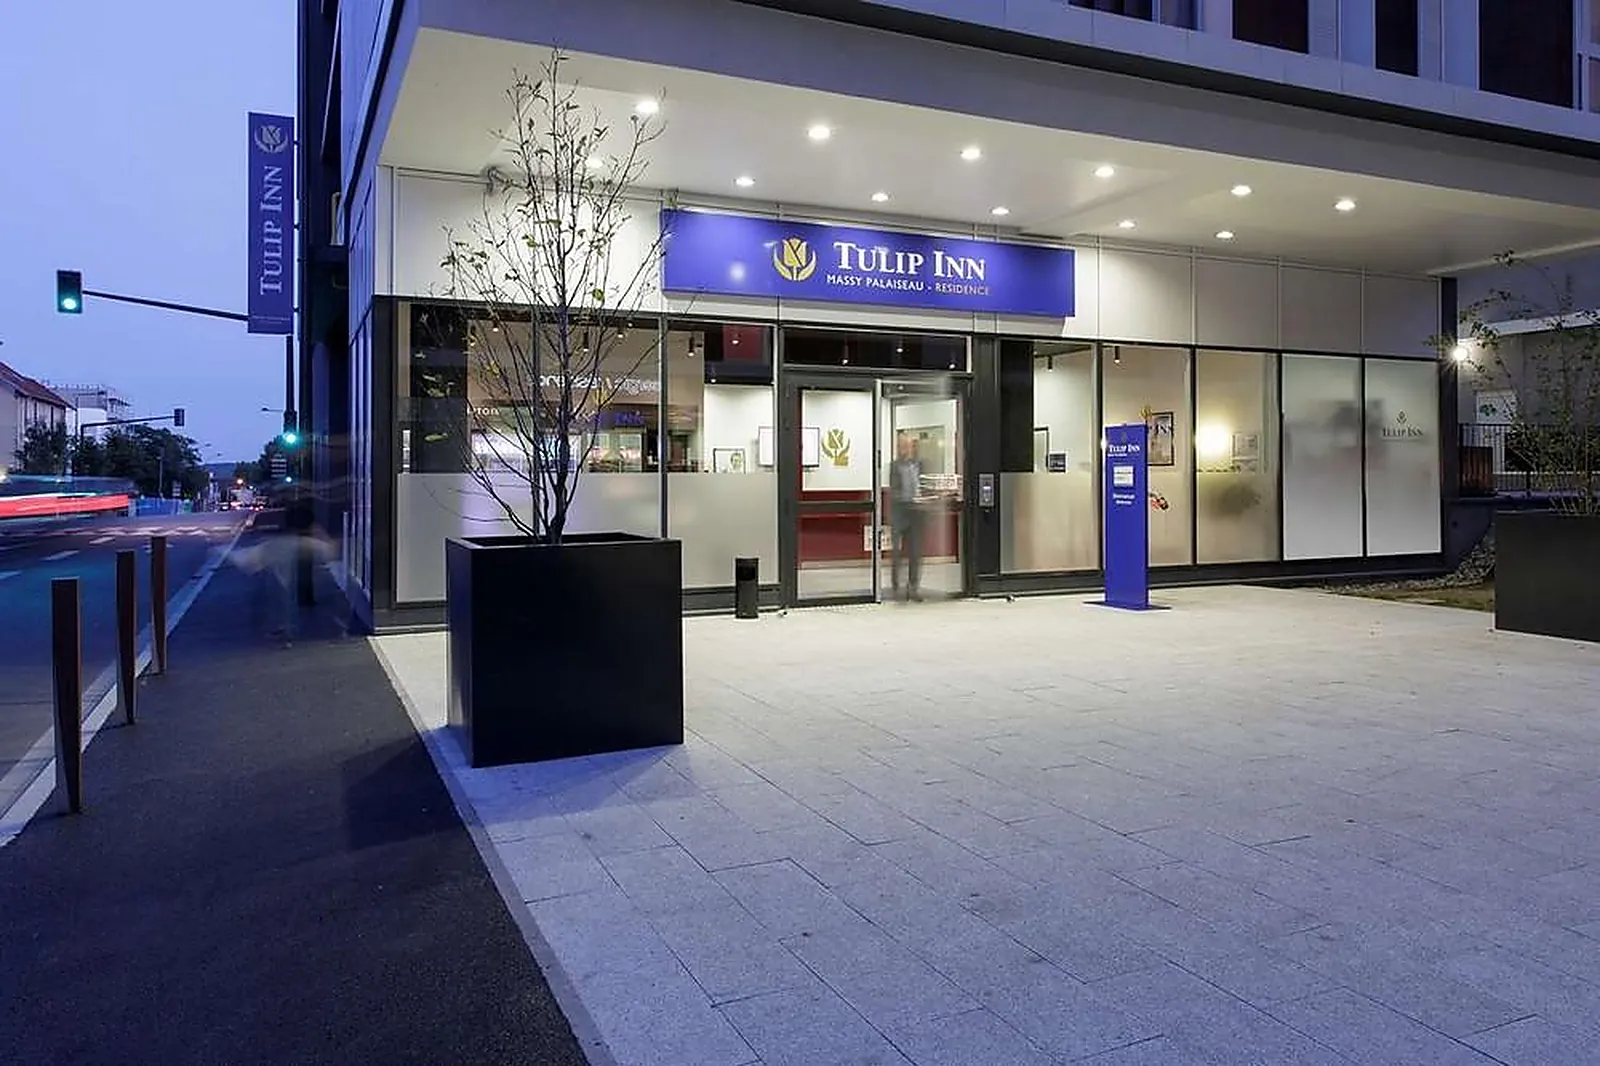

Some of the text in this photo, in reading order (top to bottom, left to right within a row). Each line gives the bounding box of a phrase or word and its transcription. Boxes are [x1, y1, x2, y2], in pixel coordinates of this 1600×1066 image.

[260, 165, 283, 212] INN
[260, 220, 283, 296] TULIP
[833, 241, 985, 280] TULIP INN
[826, 274, 862, 286] MASSY
[866, 276, 924, 291] PALAISEAU
